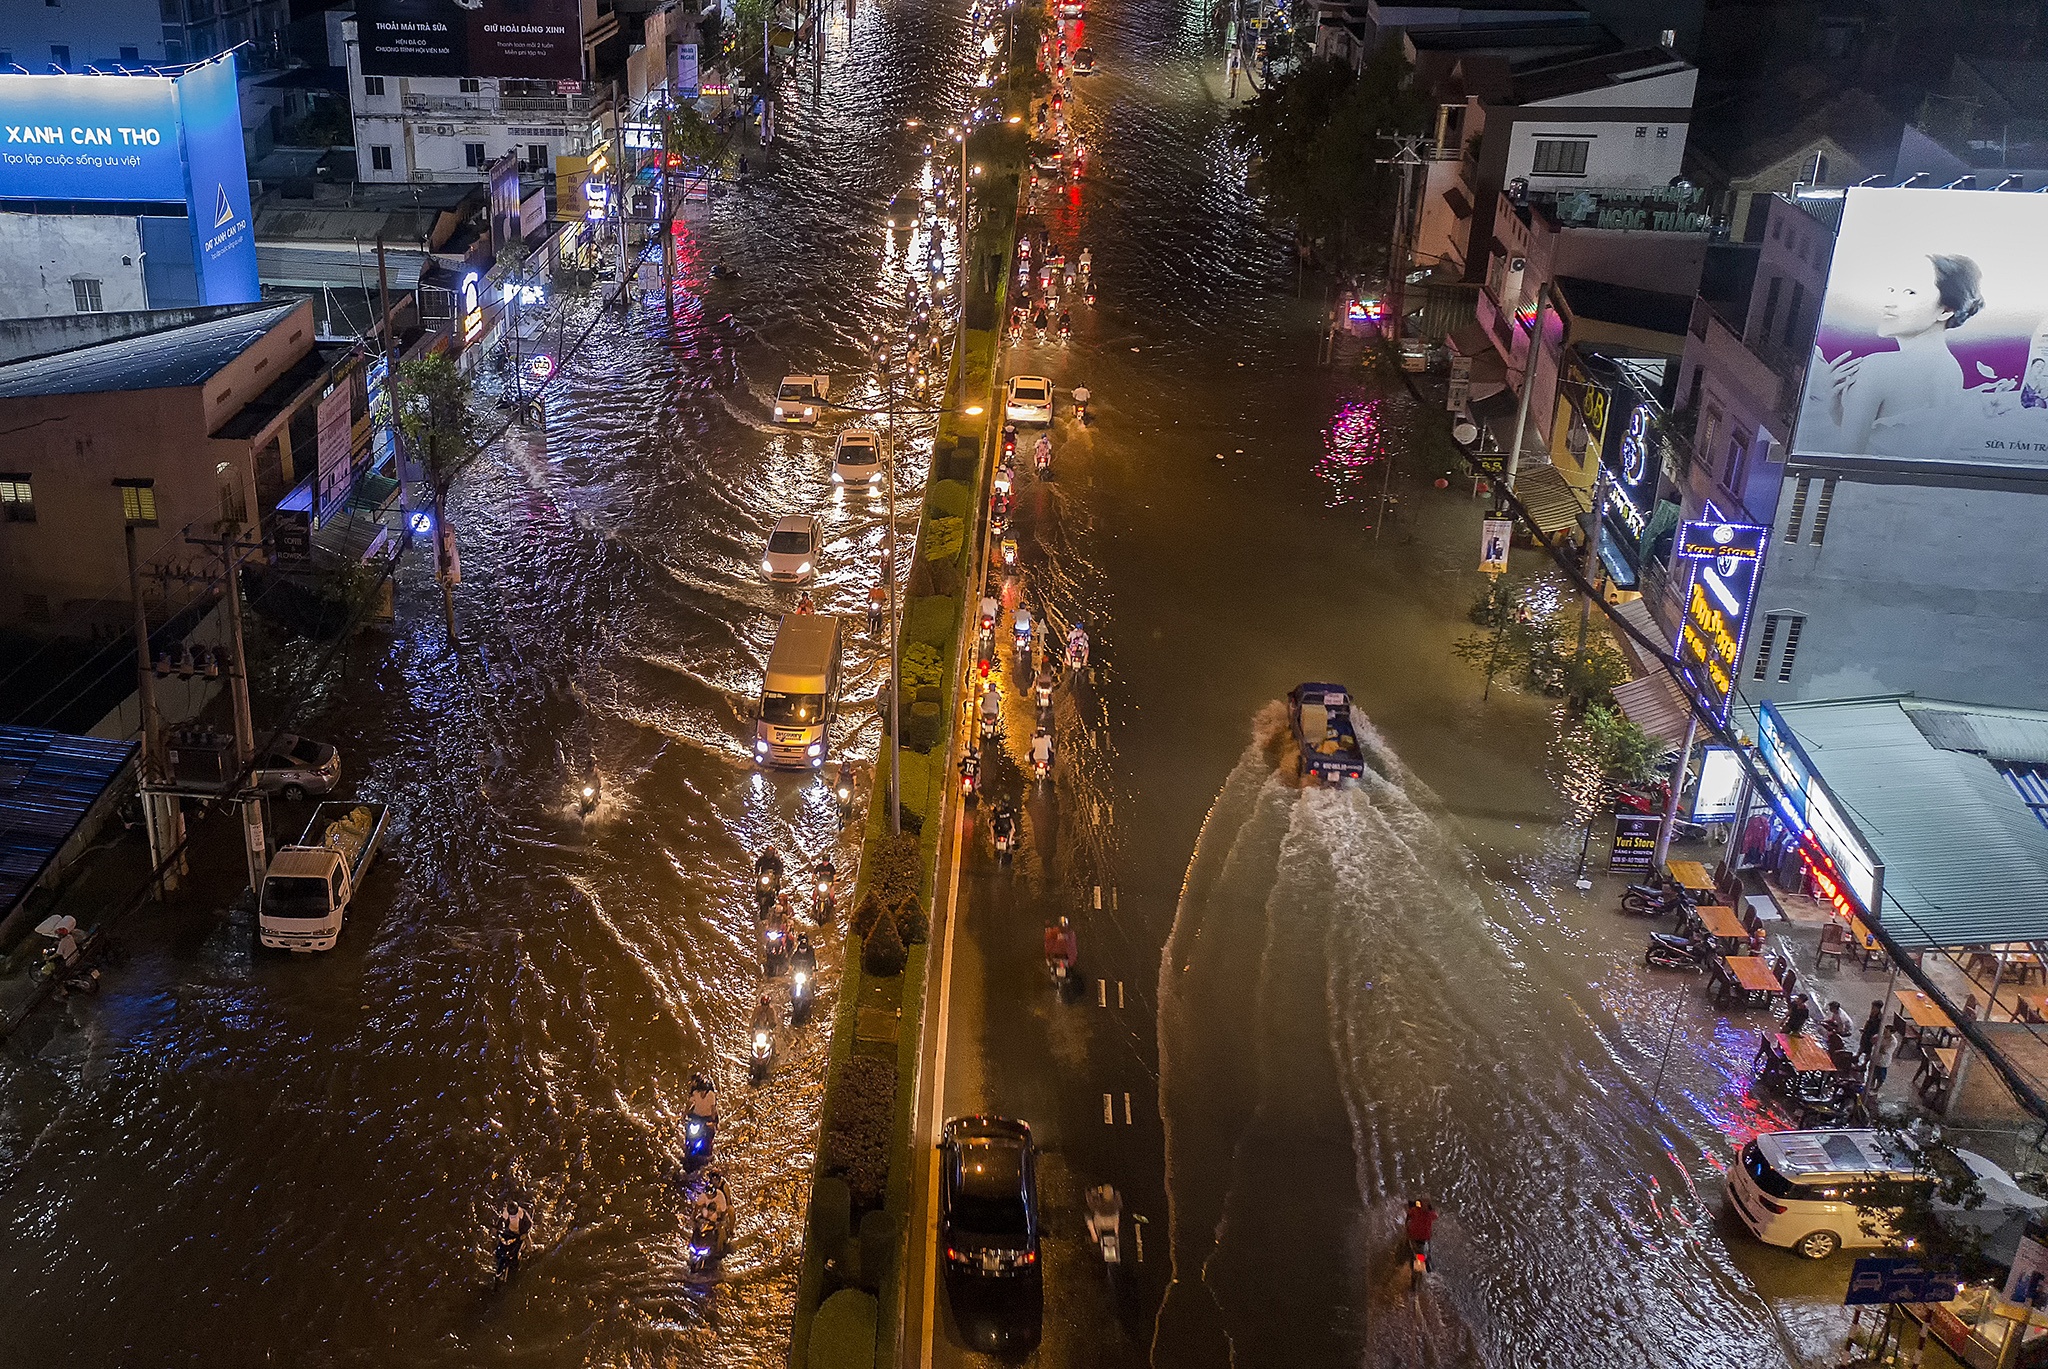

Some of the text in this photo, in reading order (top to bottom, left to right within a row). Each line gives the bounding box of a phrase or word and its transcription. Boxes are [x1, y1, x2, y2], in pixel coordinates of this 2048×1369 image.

[416, 22, 431, 31] TRÀ
[432, 22, 447, 31] SỮA
[484, 23, 565, 34] GIỮ HOÀI DÁNG XINH
[5, 126, 160, 145] XANH CAN THO
[3, 153, 141, 167] Tạo lập cuộc sống ưu việt
[1985, 439, 2005, 449] SỮA
[1719, 545, 1756, 557] Store
[1616, 836, 1655, 848] Yuri Store
